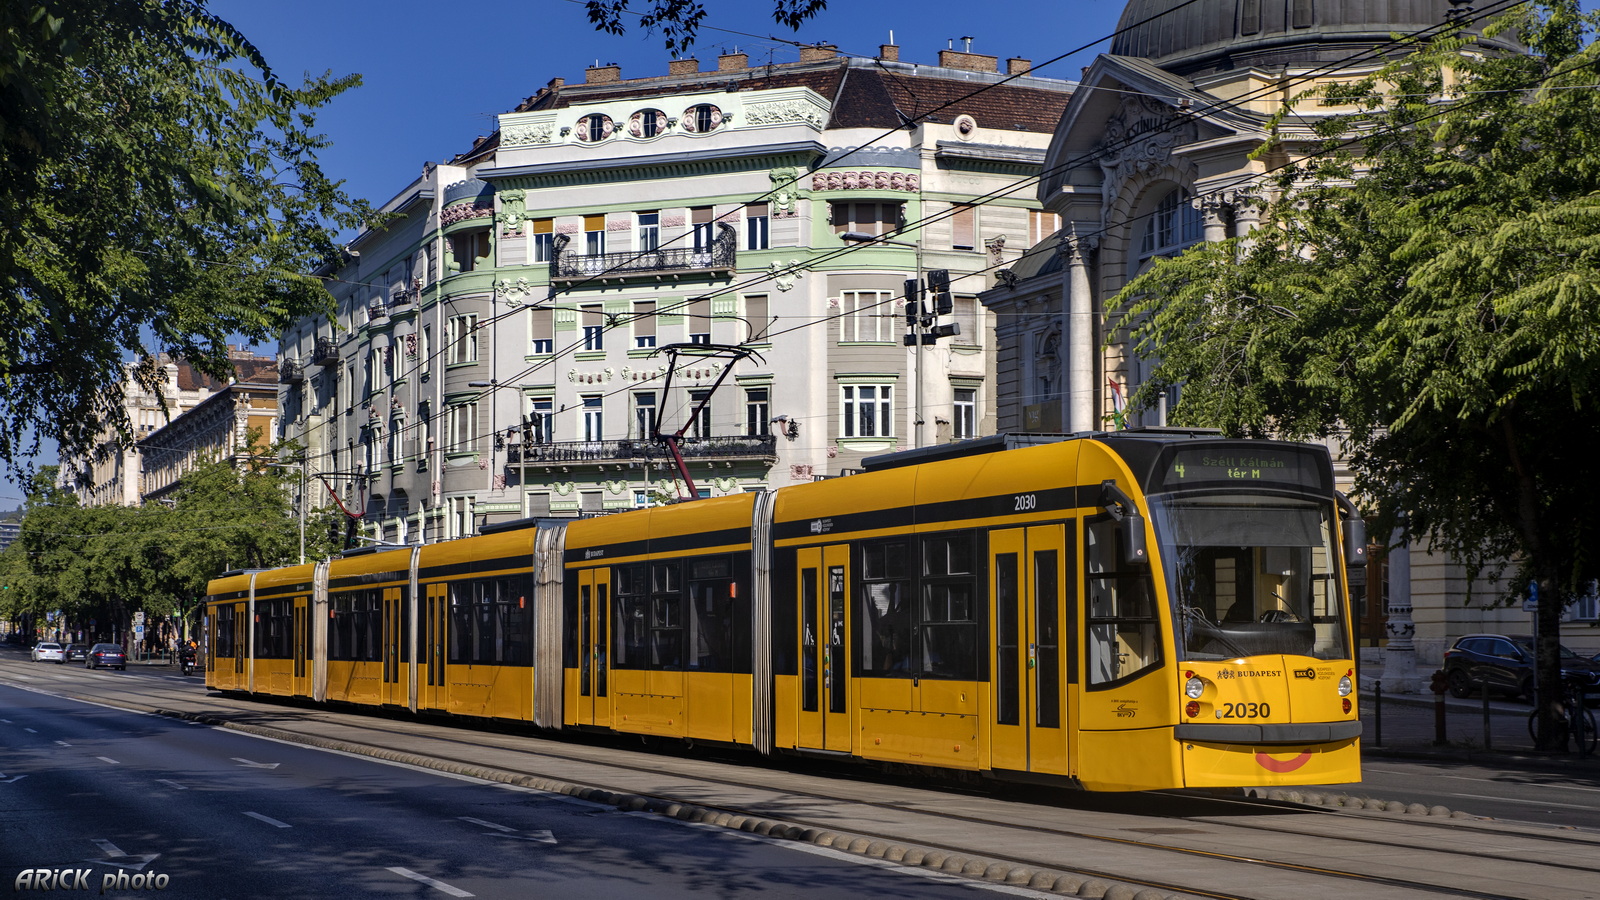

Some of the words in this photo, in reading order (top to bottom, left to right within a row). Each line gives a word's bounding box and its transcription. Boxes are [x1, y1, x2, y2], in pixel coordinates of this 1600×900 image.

[1174, 456, 1185, 478] 4
[1203, 456, 1236, 467] Széll
[1240, 457, 1285, 468] Kálmán
[1228, 468, 1247, 478] tér
[1252, 469, 1261, 479] M
[1014, 494, 1036, 511] 2030
[1223, 702, 1271, 719] 2030
